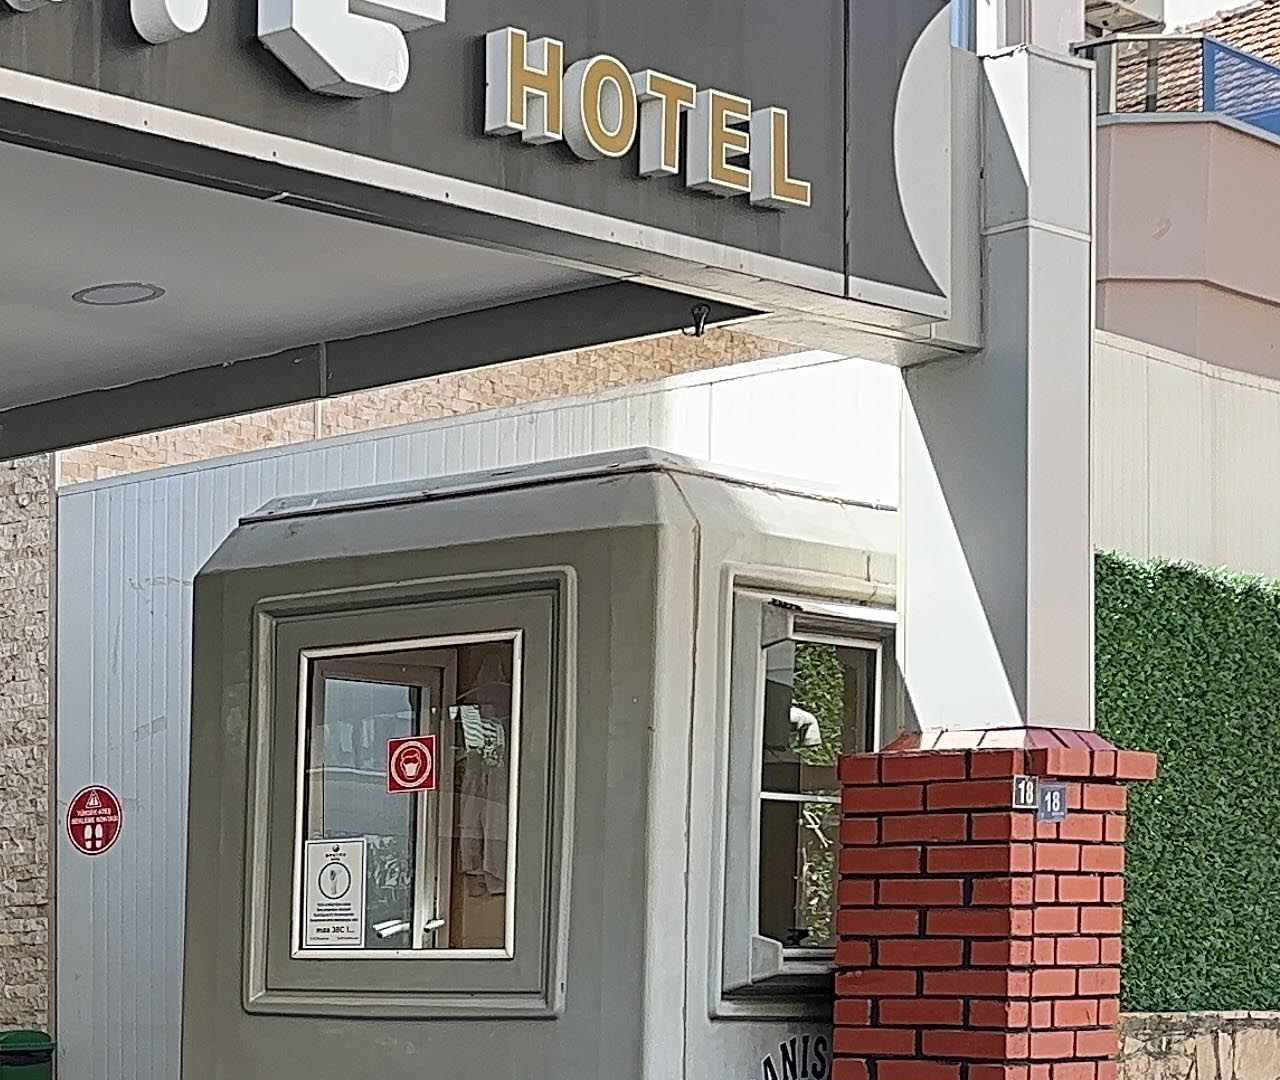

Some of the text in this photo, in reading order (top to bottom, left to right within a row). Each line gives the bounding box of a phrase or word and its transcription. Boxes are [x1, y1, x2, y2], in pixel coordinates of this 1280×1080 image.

[486, 25, 812, 208] HOTEL
[1018, 780, 1034, 804] 18
[1044, 791, 1060, 813] 18
